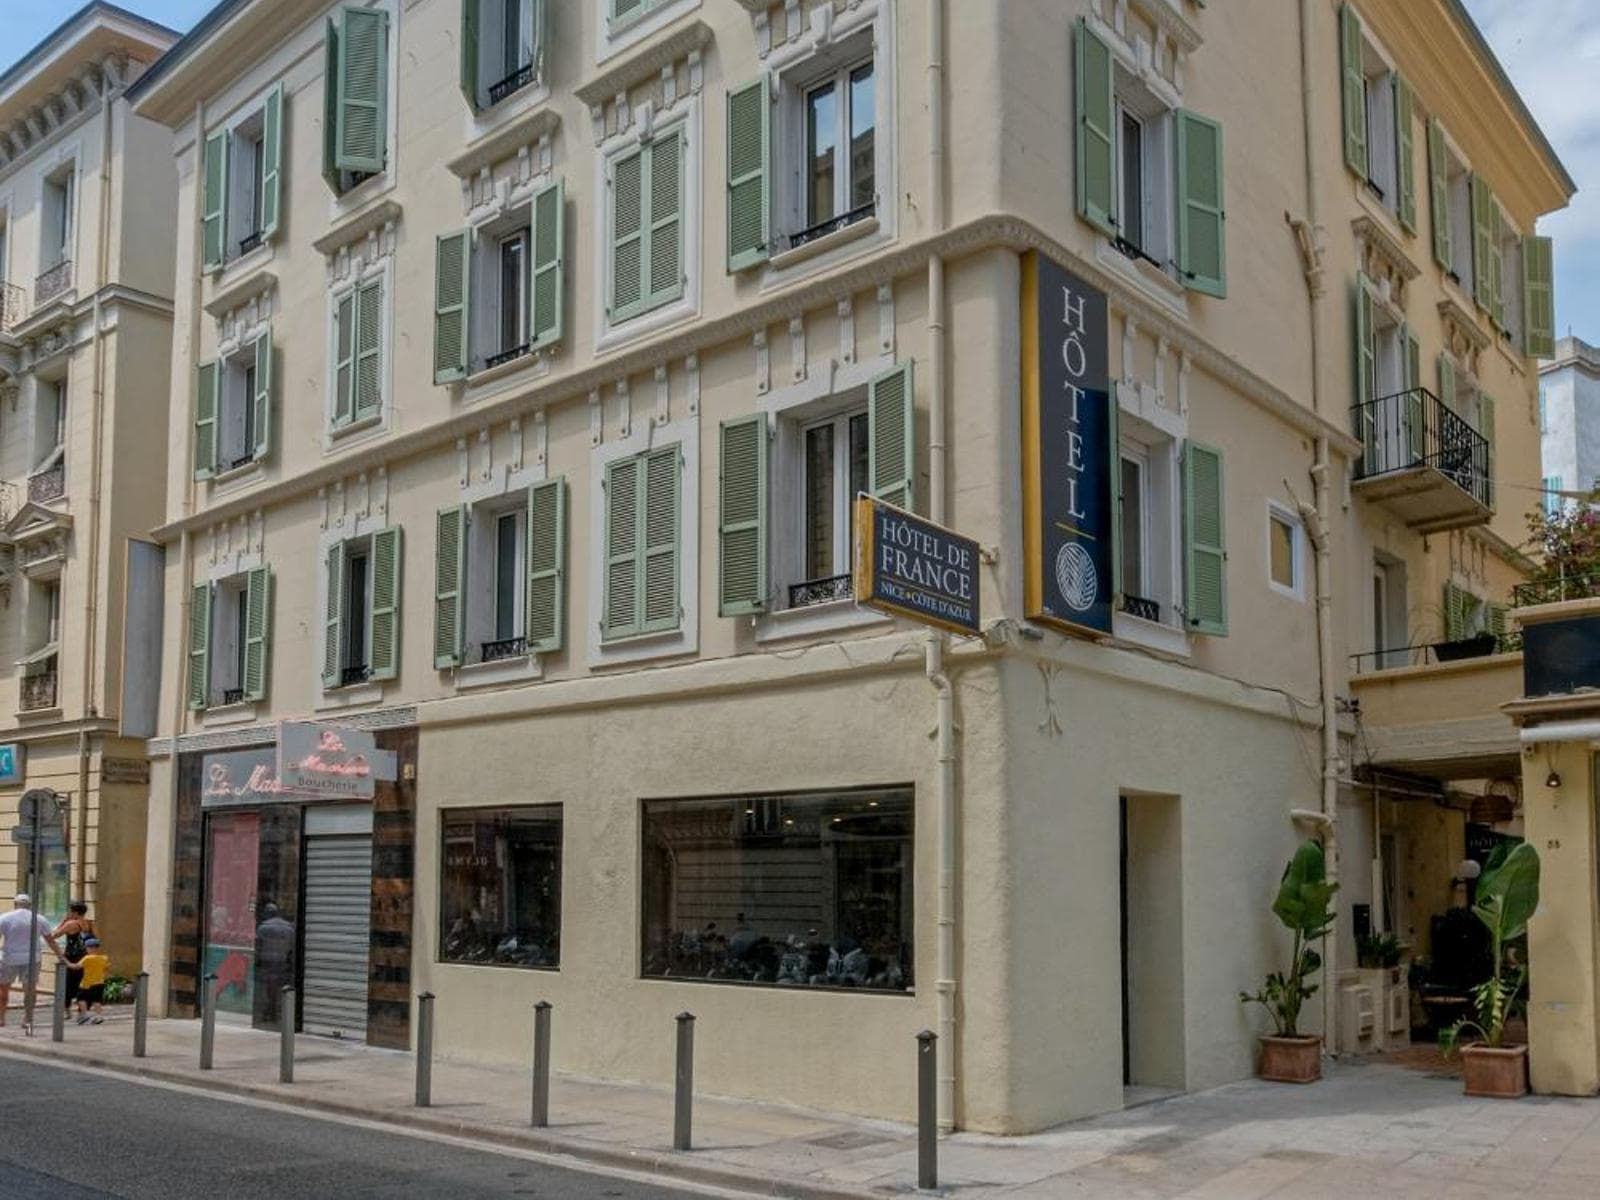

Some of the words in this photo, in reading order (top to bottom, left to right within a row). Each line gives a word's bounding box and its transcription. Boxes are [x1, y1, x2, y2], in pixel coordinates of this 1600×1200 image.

[1062, 286, 1087, 520] HÔTEL
[882, 518, 943, 560] HÔTEL
[948, 544, 970, 570] DE
[881, 581, 905, 600] NICE
[882, 545, 971, 599] FRANCE
